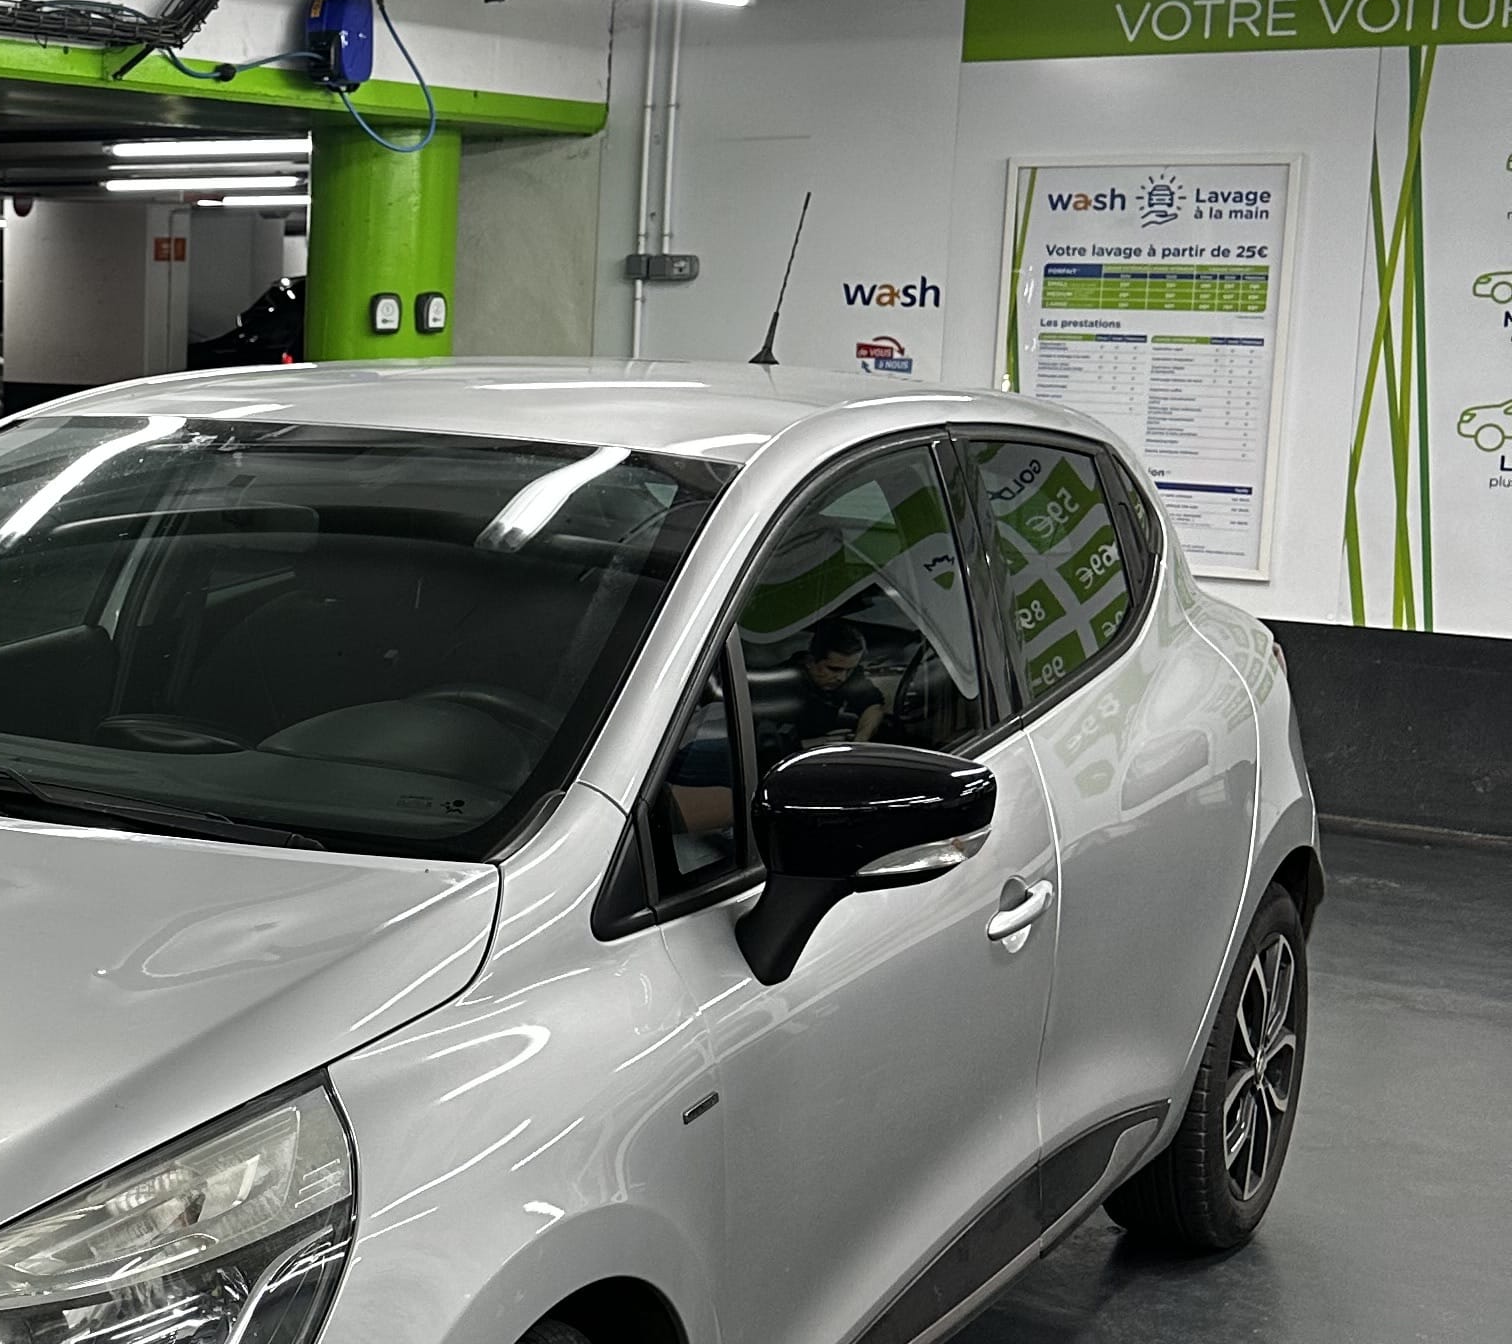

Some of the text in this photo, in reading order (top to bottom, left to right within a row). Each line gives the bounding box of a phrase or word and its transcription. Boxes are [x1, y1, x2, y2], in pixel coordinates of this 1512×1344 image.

[1048, 187, 1126, 211] wash
[1195, 188, 1271, 206] Lavage
[1194, 206, 1269, 219] à la main
[1046, 244, 1268, 259] Votre lavage à partir de 25€
[843, 275, 940, 308] wash
[1040, 319, 1121, 329] Les prestations
[885, 360, 909, 369] NOUS
